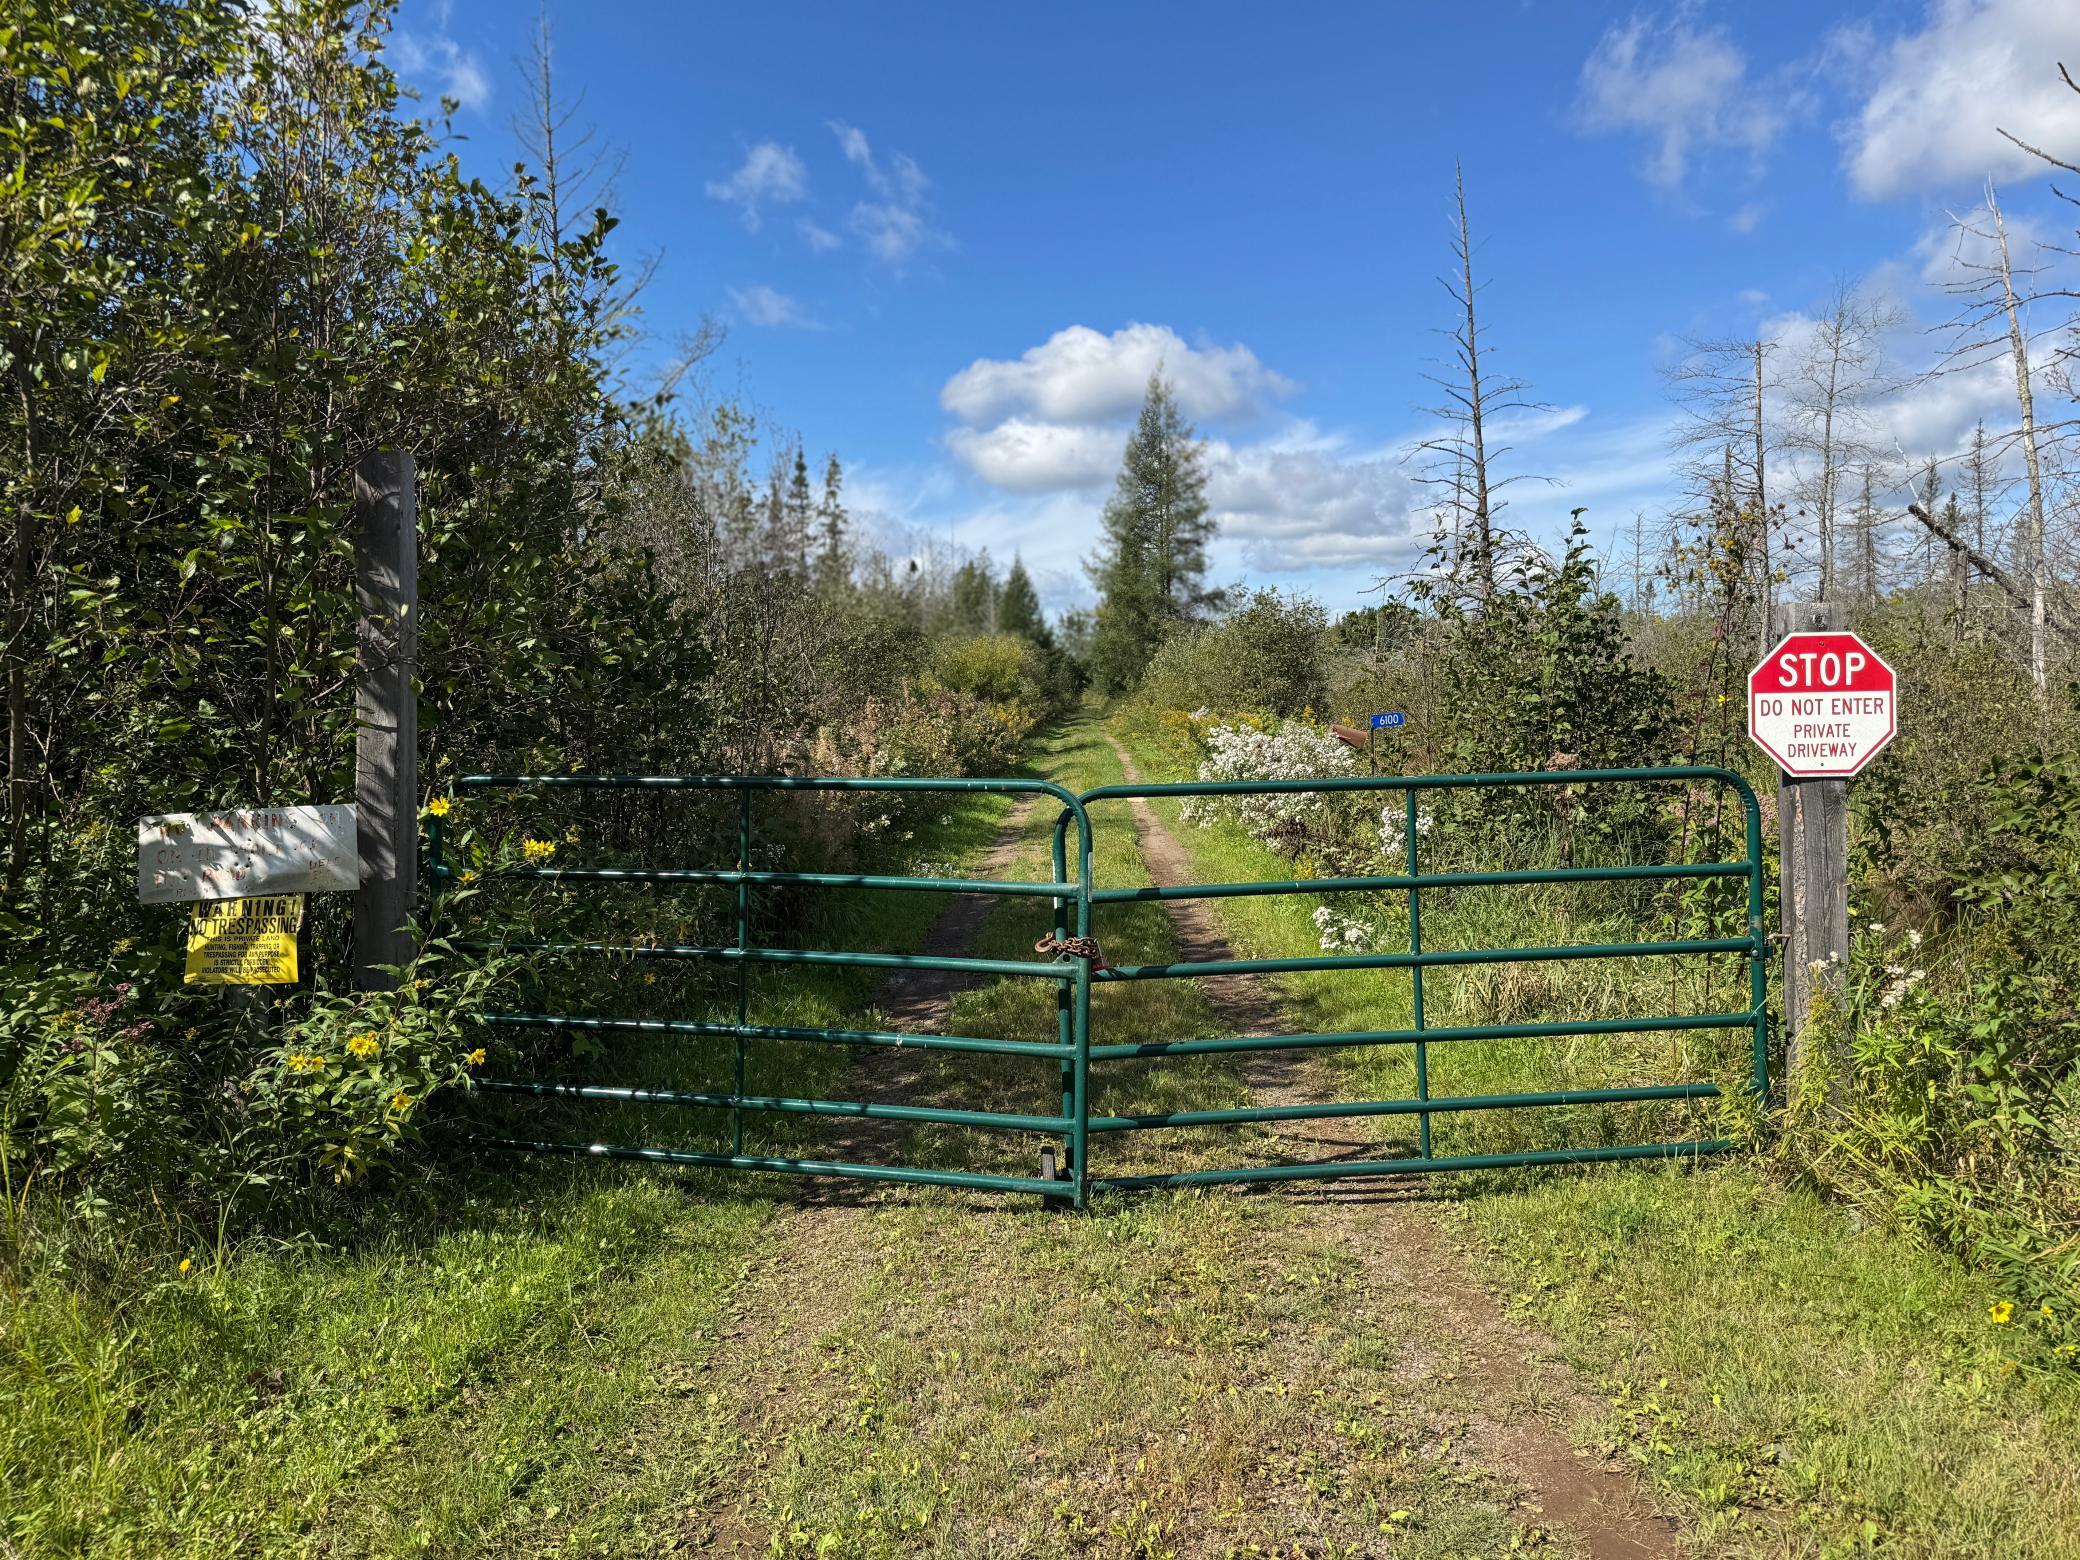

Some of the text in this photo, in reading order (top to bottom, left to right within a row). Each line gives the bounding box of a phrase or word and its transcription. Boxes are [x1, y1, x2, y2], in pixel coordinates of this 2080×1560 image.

[1778, 652, 1866, 687] STOP
[1760, 697, 1884, 717] DO NOT ENTER
[1379, 714, 1399, 725] 6100
[1793, 723, 1851, 738] PRIVATE
[1787, 742, 1857, 758] DRIVEWAY
[190, 916, 298, 935] NO TRESPASSING
